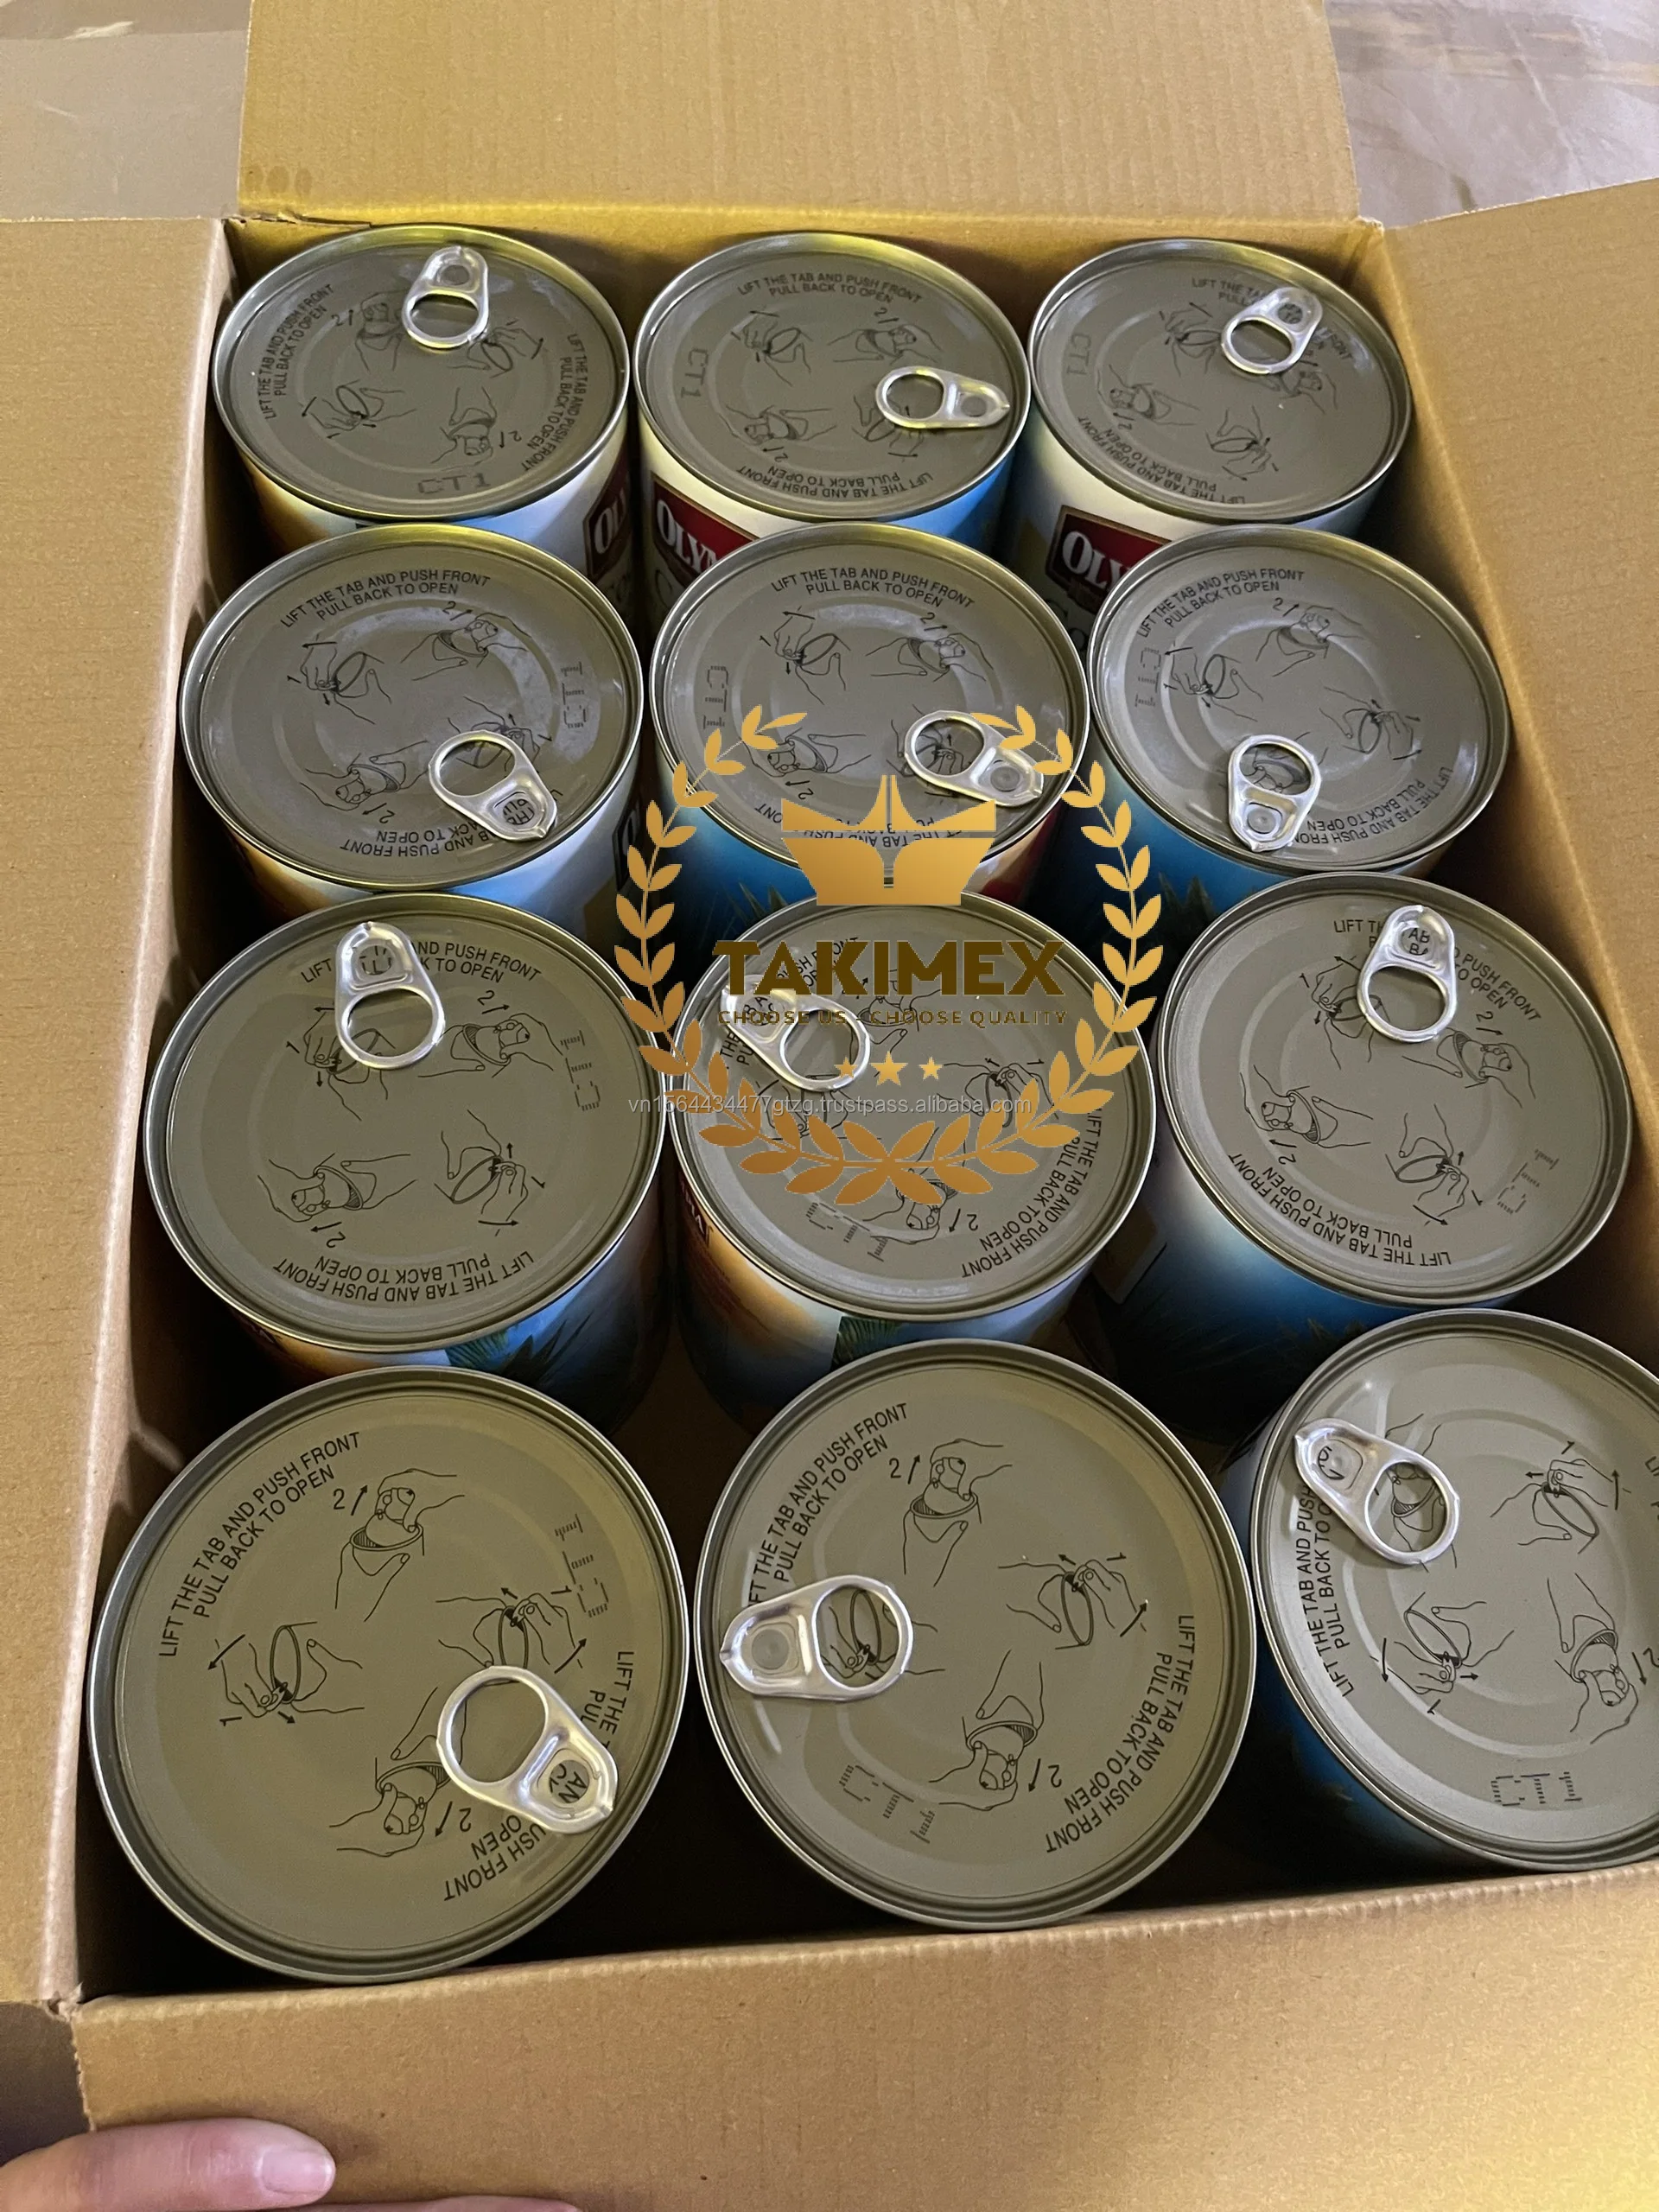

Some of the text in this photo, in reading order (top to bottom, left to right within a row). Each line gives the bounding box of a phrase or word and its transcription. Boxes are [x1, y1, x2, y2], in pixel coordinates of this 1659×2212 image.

[257, 284, 334, 419] LIFT THE TAB AND PUSH FRONT
[274, 304, 327, 396] PULL BACK TO OPEN
[417, 473, 491, 494] CT1
[737, 465, 933, 499] LIFT THE TAB AND PUSH FRONT
[767, 466, 900, 488] PULL BACK TO OPEN
[280, 569, 491, 627] LIFT THE TAB AND PUSH FRONT
[316, 582, 458, 620] PULL BACK TO OPEN
[771, 568, 975, 608] LIFT THE TAB AND PUSH FRONT
[805, 580, 944, 607] PULL BACK TO OPEN
[1136, 569, 1305, 638] LIFT THE TAB AND PUSH FRONT
[1164, 582, 1280, 628] PULL BACK TO OPEN
[301, 943, 542, 983] LIFT PUSH FRONT
[435, 958, 504, 983] TO OPEN
[1333, 919, 1541, 1020] LIFT PUSH FRONT
[1471, 977, 1508, 1009] OPEN
[962, 1141, 1099, 1278] THE TAB AND PUSH FRONT
[1033, 1170, 1066, 1207] BACK
[1228, 1153, 1452, 1267] LIFT THE TAB AND PUSH FRONT
[1262, 1166, 1413, 1249] PULL BACK TO OPEN
[979, 1220, 1020, 1251] OPEN
[1018, 1205, 1040, 1224] TO
[273, 1250, 535, 1302] LIFT THE TAB AND PUSH FRONT
[315, 1253, 491, 1285] PULL BACK TO OPEN
[753, 1540, 779, 1574] THE
[767, 1504, 795, 1537] TAB
[789, 1470, 818, 1506] AND
[813, 1432, 856, 1472] PUSH
[854, 1402, 907, 1440] FRONT
[774, 1434, 888, 1583] PULL BACK TO OPEN
[159, 1431, 359, 1656] LIFT THE TAB AND PUSH FRONT
[193, 1464, 335, 1618] PULL BACK TO OPEN
[1314, 1520, 1331, 1543] TO
[1296, 1538, 1312, 1574] AND
[1314, 1549, 1334, 1599] BACK
[1299, 1580, 1319, 1615] TAB
[1307, 1618, 1332, 1657] THE
[1324, 1604, 1350, 1649] PULL
[1324, 1661, 1354, 1697] LIFT
[1046, 1615, 1195, 1853] LIFT THE TAB AND PUSH FRONT
[1064, 1652, 1173, 1815] PULL BACK TO OPEN
[444, 1651, 634, 1901] LIFT THE USH FRONT
[1491, 1771, 1583, 1807] CT1
[471, 1815, 522, 1860] OPEN
